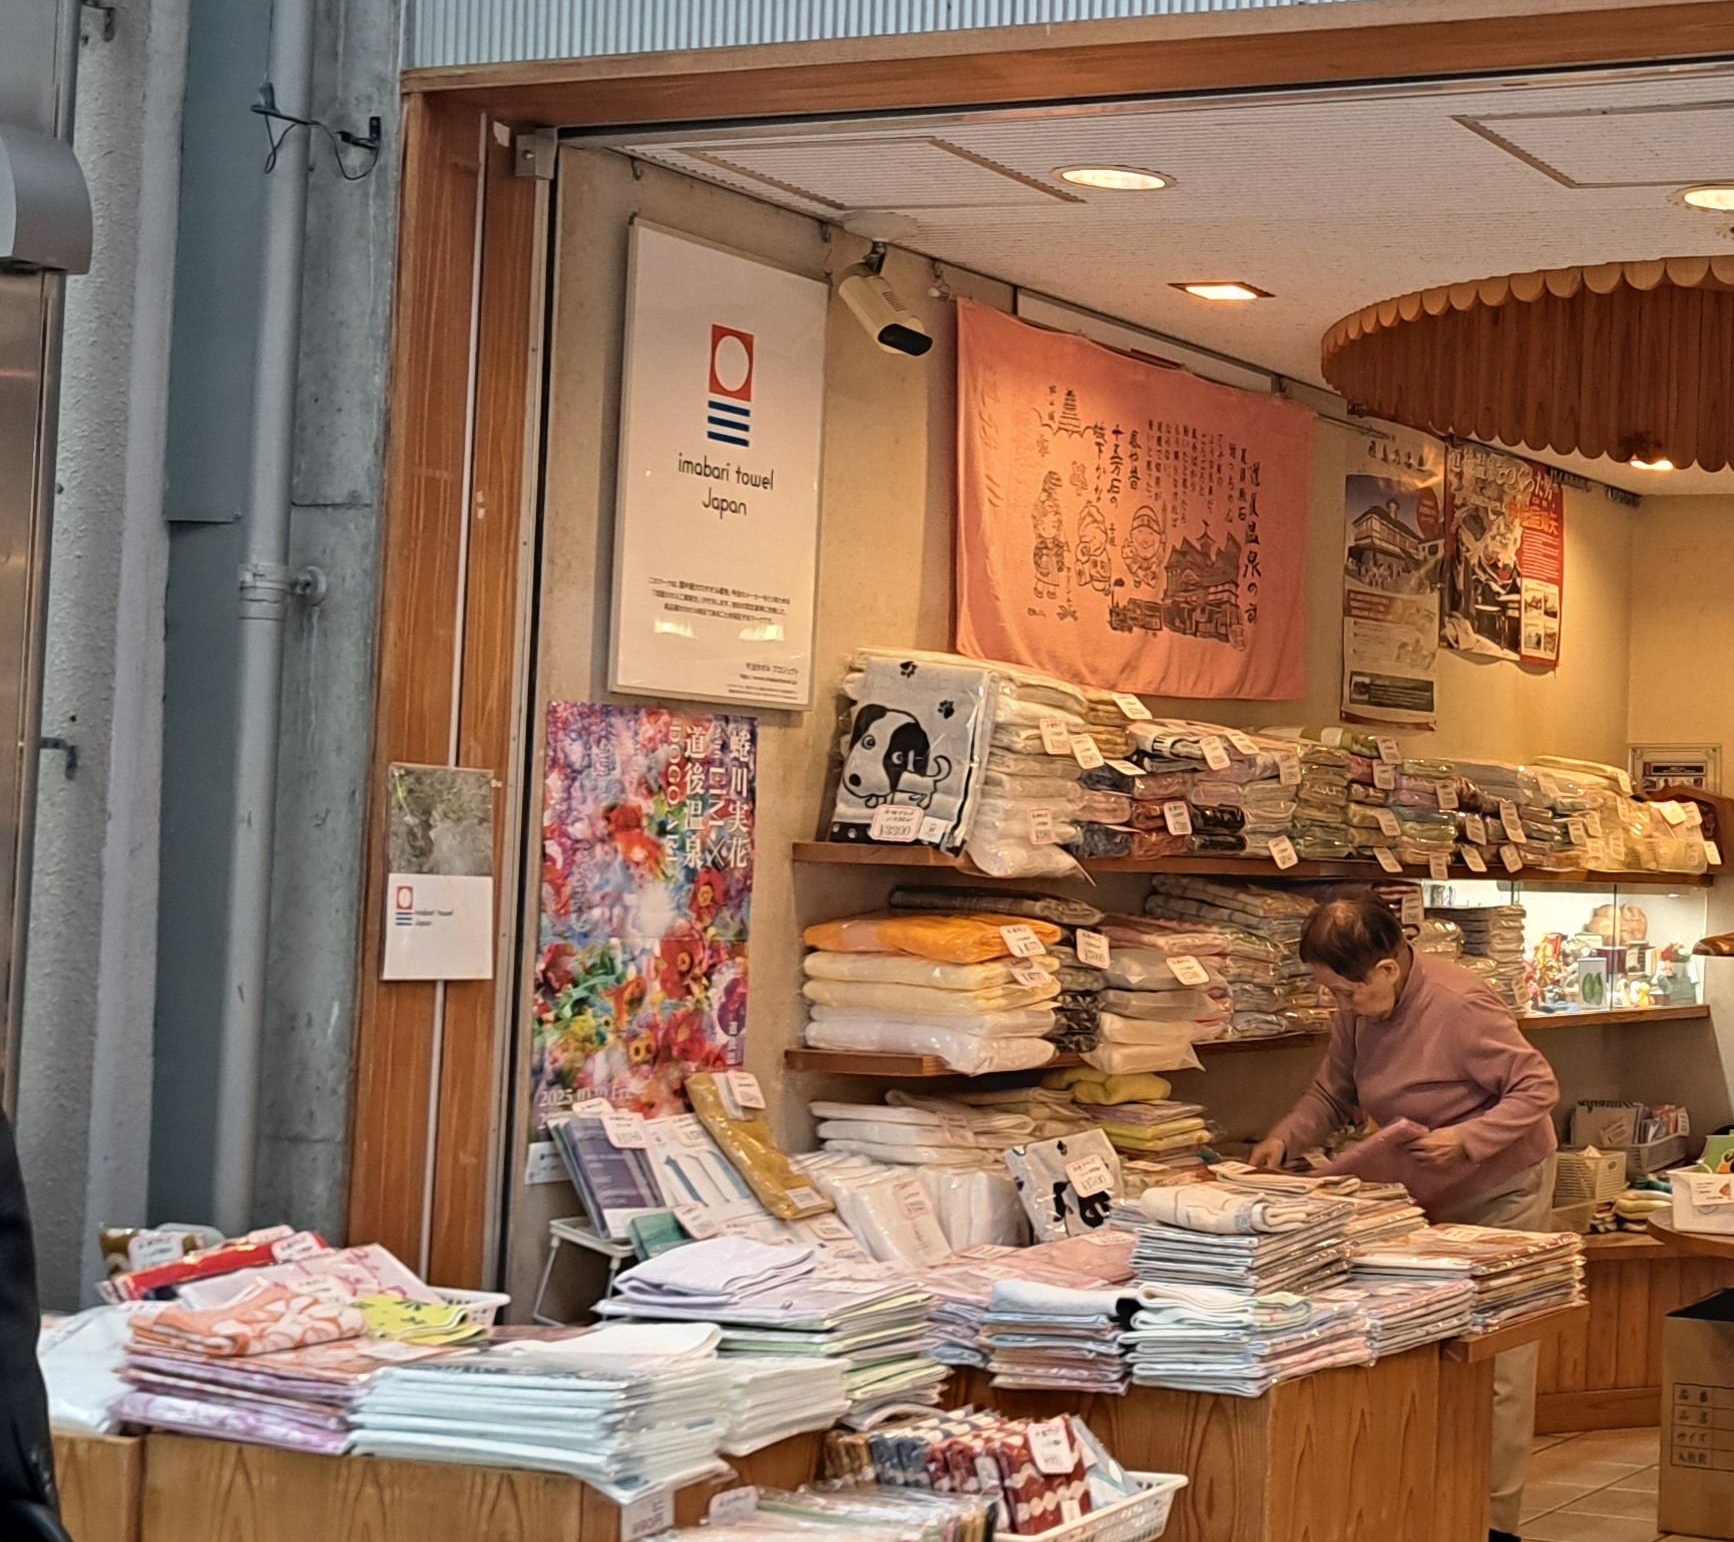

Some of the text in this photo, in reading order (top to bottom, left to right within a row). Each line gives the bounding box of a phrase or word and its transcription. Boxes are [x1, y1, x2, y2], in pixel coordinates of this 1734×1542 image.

[678, 452, 775, 491] imabari towel
[702, 486, 748, 520] Japan
[667, 725, 683, 805] DOGO
[683, 725, 707, 869] 道後温泉
[728, 729, 752, 869] 蜷川実花
[538, 1088, 574, 1107] 2025
